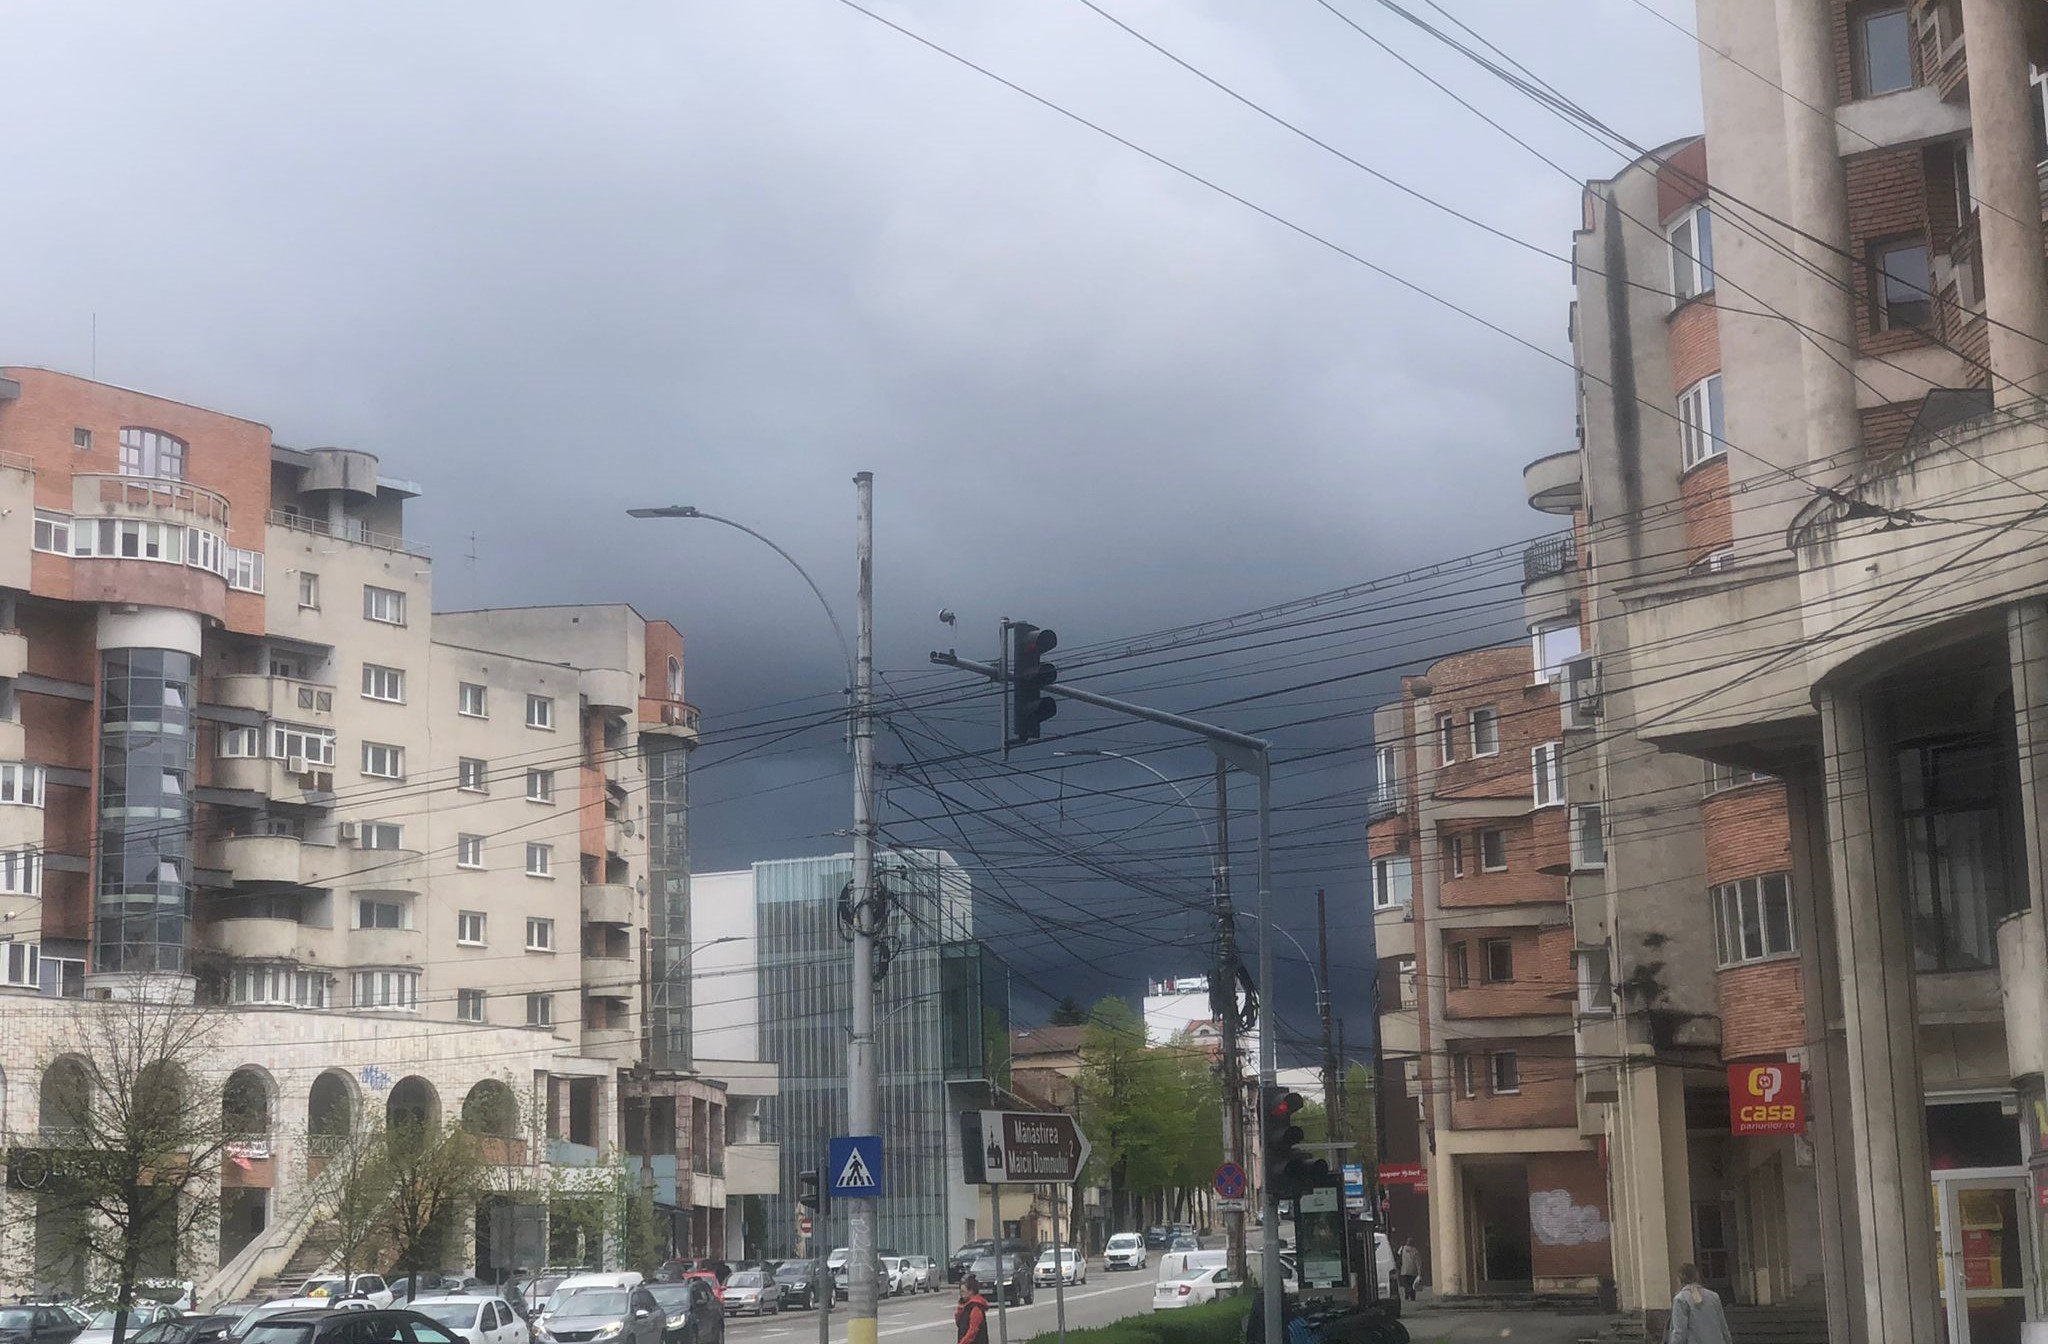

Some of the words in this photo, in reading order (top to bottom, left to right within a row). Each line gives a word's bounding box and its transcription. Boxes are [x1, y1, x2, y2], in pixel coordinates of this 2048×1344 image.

[1740, 1105, 1796, 1122] casa
[1740, 1122, 1796, 1131] pariurilor.ro
[1069, 1140, 1075, 1158] 2
[1033, 1151, 1069, 1174] Domnului
